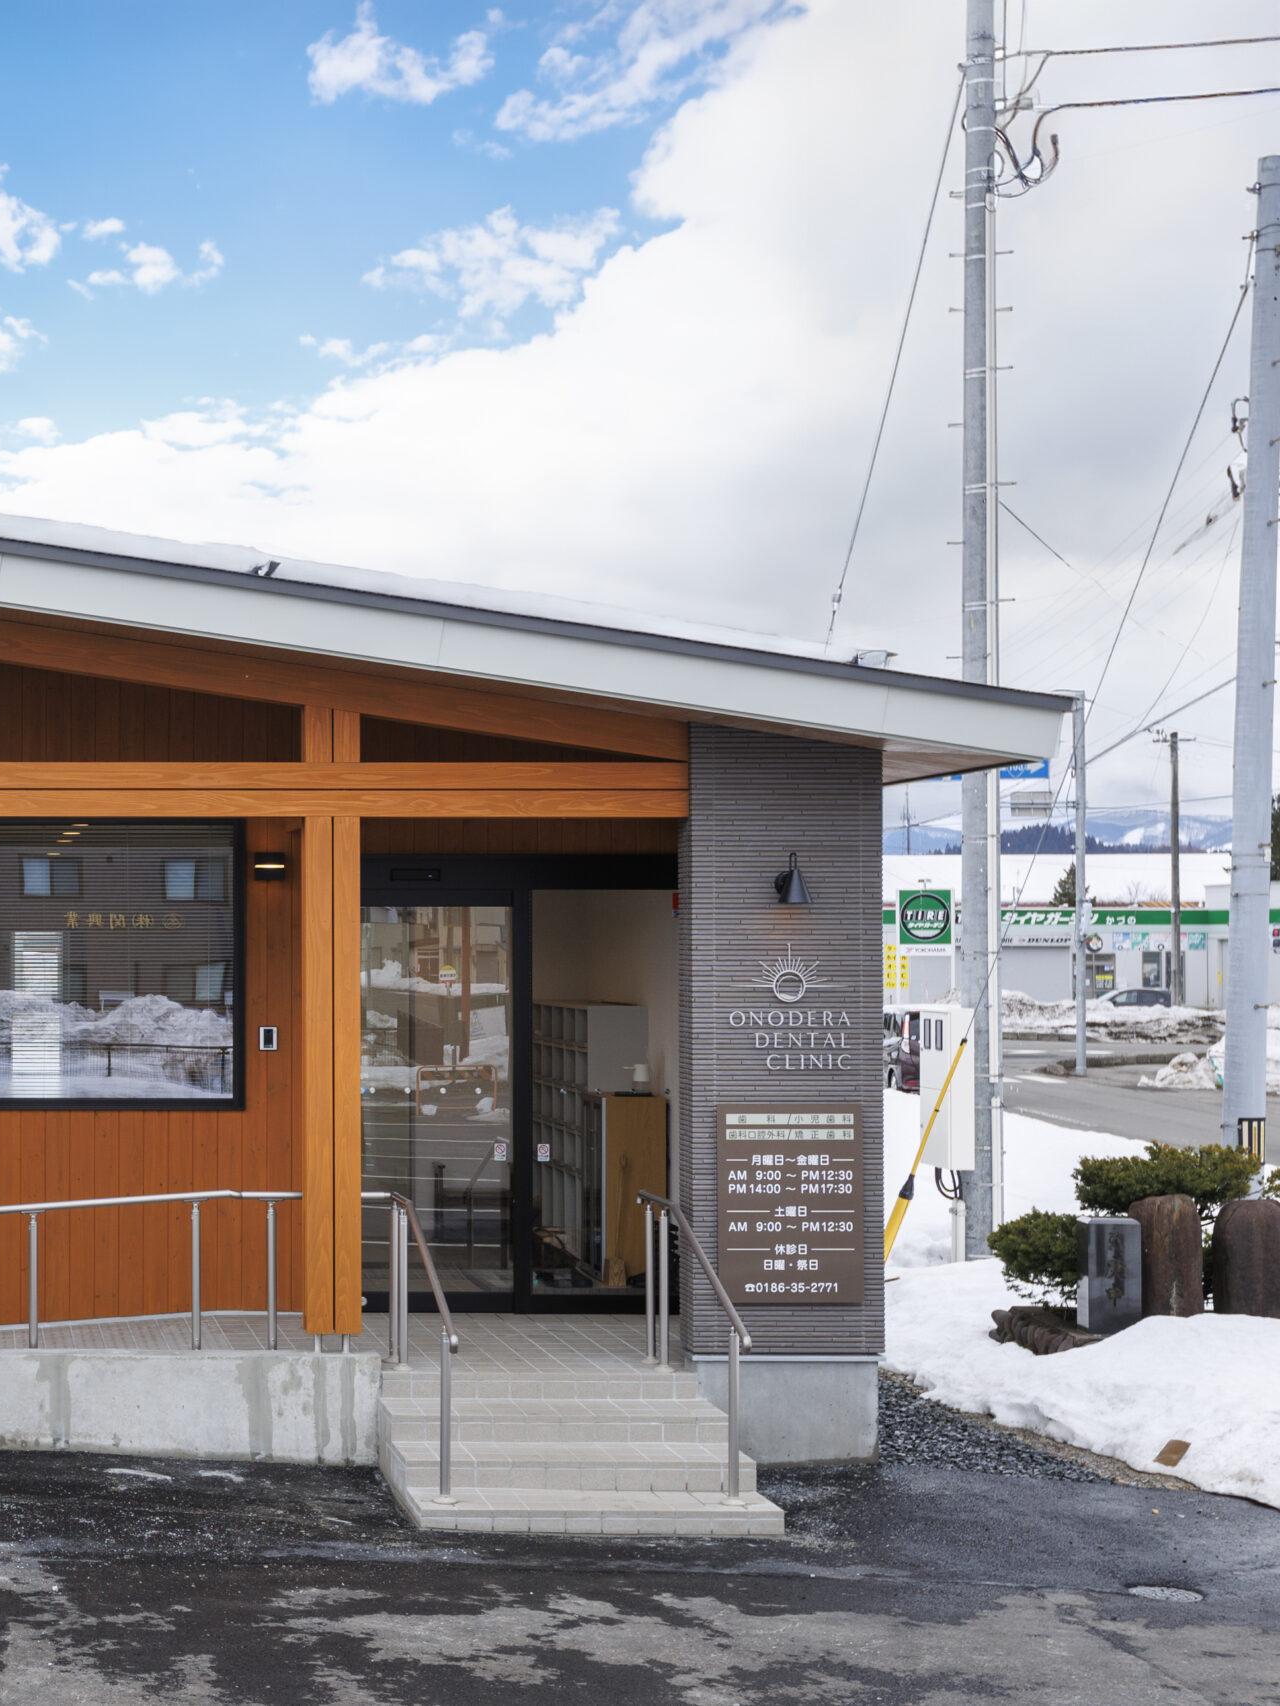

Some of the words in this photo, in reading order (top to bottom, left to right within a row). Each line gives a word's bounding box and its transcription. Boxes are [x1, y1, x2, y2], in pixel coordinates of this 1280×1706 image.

[906, 910, 945, 921] TIRE
[1105, 915, 1136, 926] かづの
[729, 1010, 851, 1027] ONODERA
[755, 1032, 851, 1048] DENTAL
[766, 1054, 852, 1070] CLINIC
[728, 1170, 748, 1181] AM
[755, 1170, 782, 1181] 9:00
[728, 1183, 747, 1194] PM
[749, 1183, 781, 1194] 14:00
[774, 1205, 808, 1217] 土曜日
[728, 1221, 748, 1232] AM
[755, 1221, 782, 1232] 9:00
[774, 1243, 808, 1255] 休診日
[763, 1259, 819, 1271] 日曜・祭日
[755, 1282, 839, 1293] 0186-35-2771
